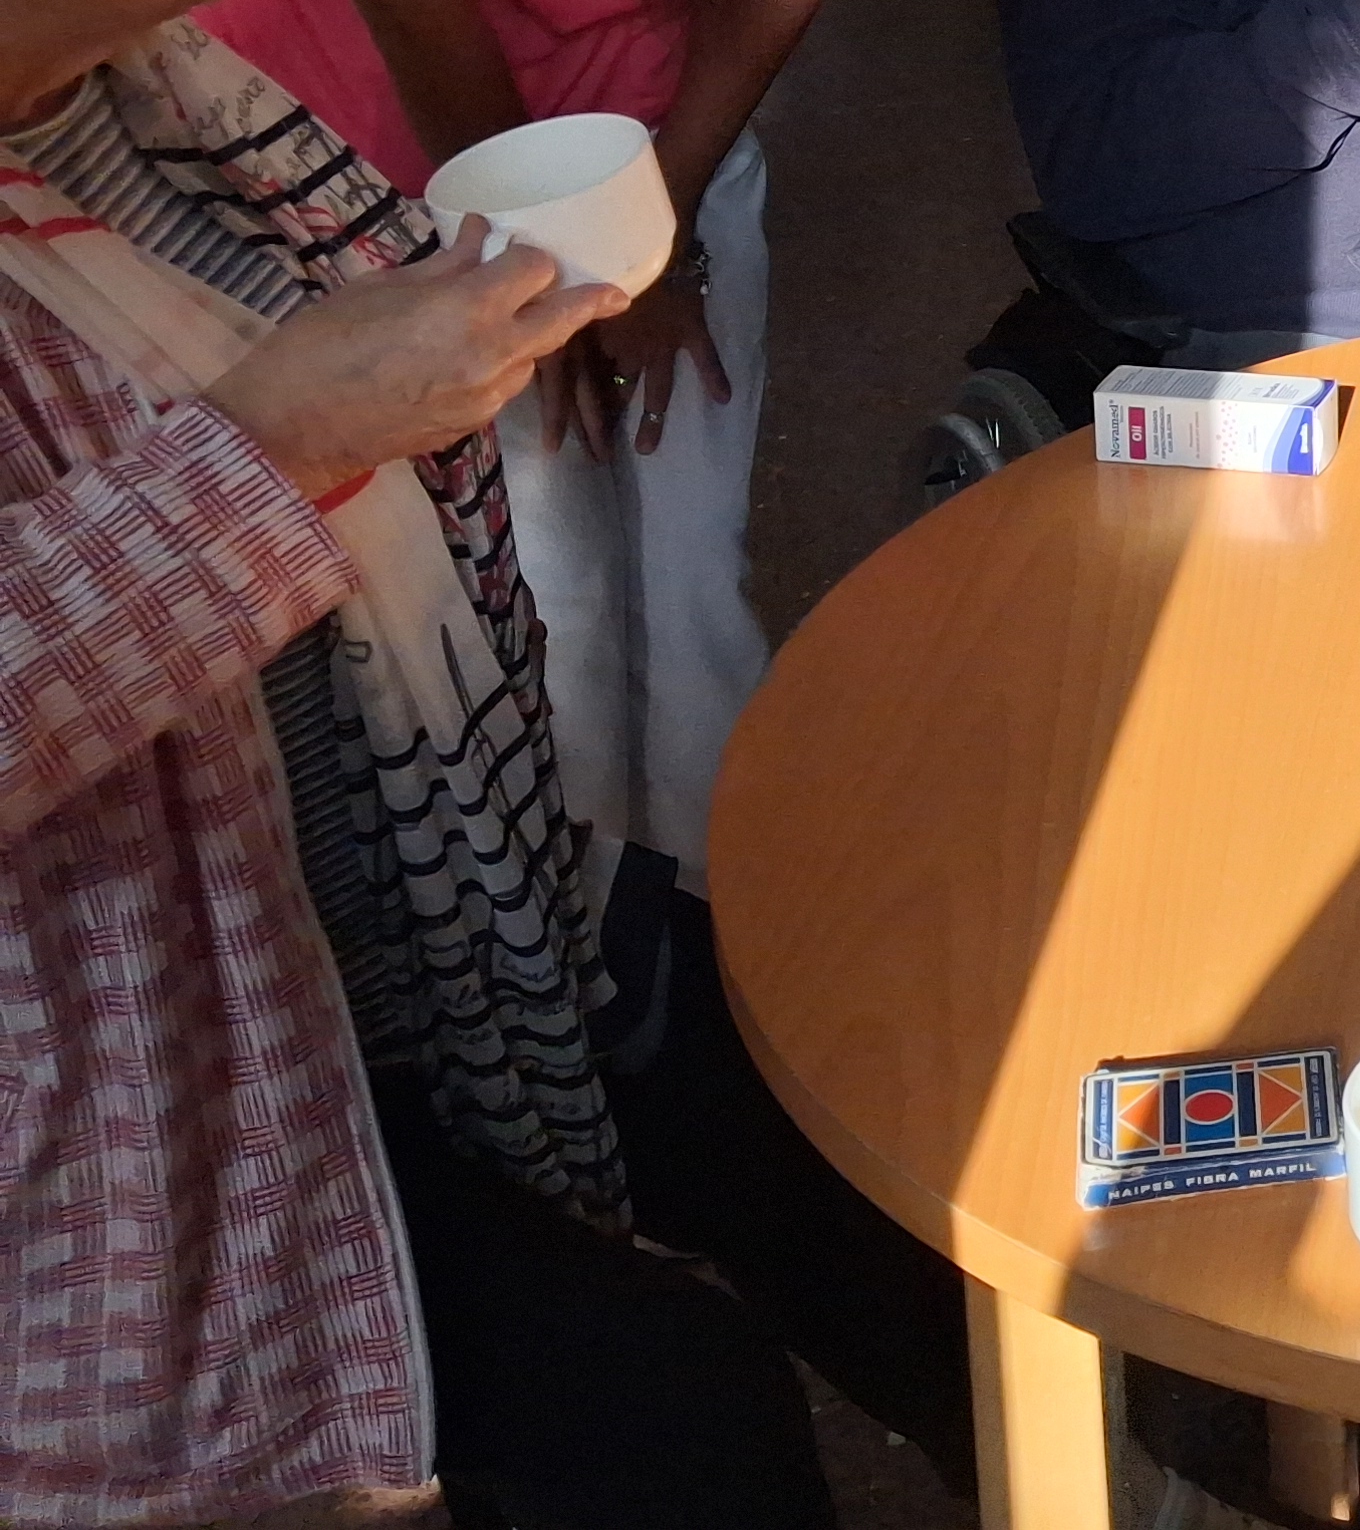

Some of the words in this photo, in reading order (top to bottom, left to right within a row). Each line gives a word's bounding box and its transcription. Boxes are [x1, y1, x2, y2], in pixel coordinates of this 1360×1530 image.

[1108, 1180, 1176, 1200] NAIPES
[1185, 1172, 1240, 1187] FIBRA
[1248, 1162, 1317, 1179] MARFIL
